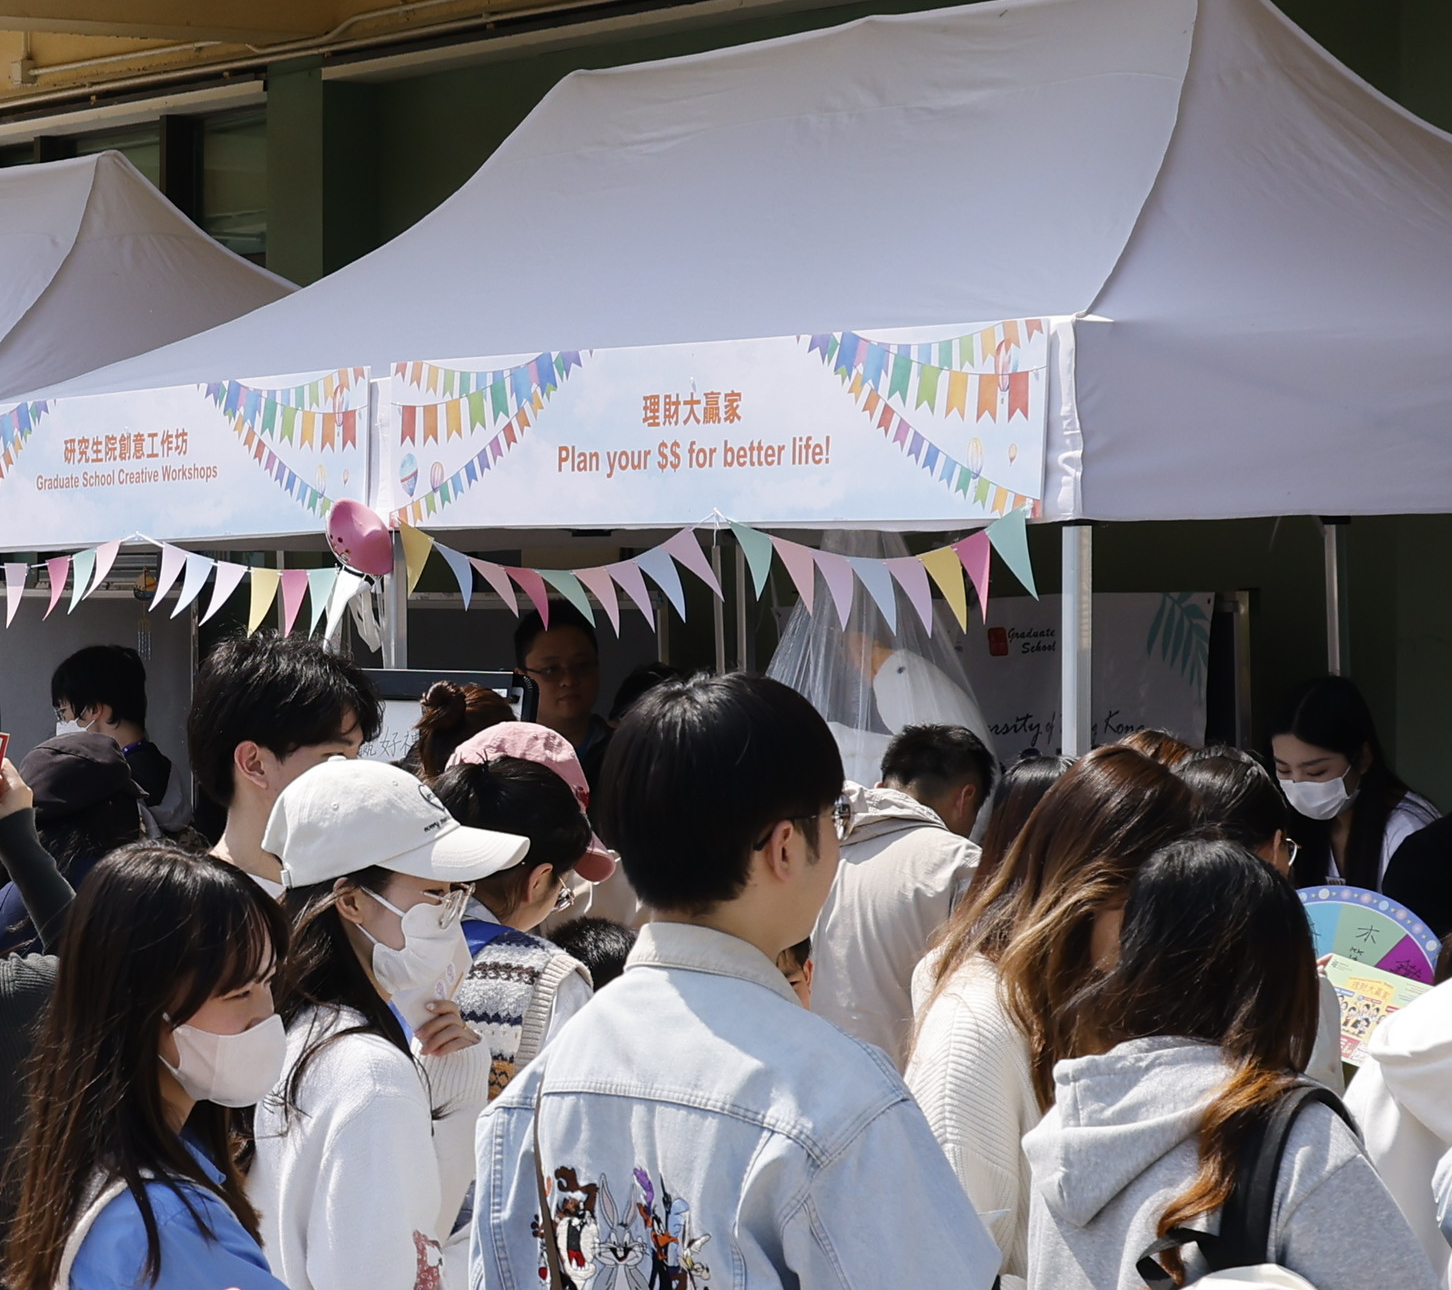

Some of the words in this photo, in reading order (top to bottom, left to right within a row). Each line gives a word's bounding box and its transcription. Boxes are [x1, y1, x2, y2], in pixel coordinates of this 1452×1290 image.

[642, 390, 742, 428] 理財大贏家
[63, 428, 189, 465] 研究生院創意工作坊
[557, 445, 599, 472] Plan
[606, 449, 651, 478] your
[657, 440, 681, 473] $$
[688, 440, 717, 469] for
[723, 439, 786, 468] better
[791, 435, 831, 465] life!
[36, 472, 80, 491] Graduate
[82, 469, 115, 488] School
[118, 466, 159, 485] Creative
[161, 463, 218, 483] Workshops
[1008, 628, 1055, 643] Graduate
[1021, 641, 1056, 654] School
